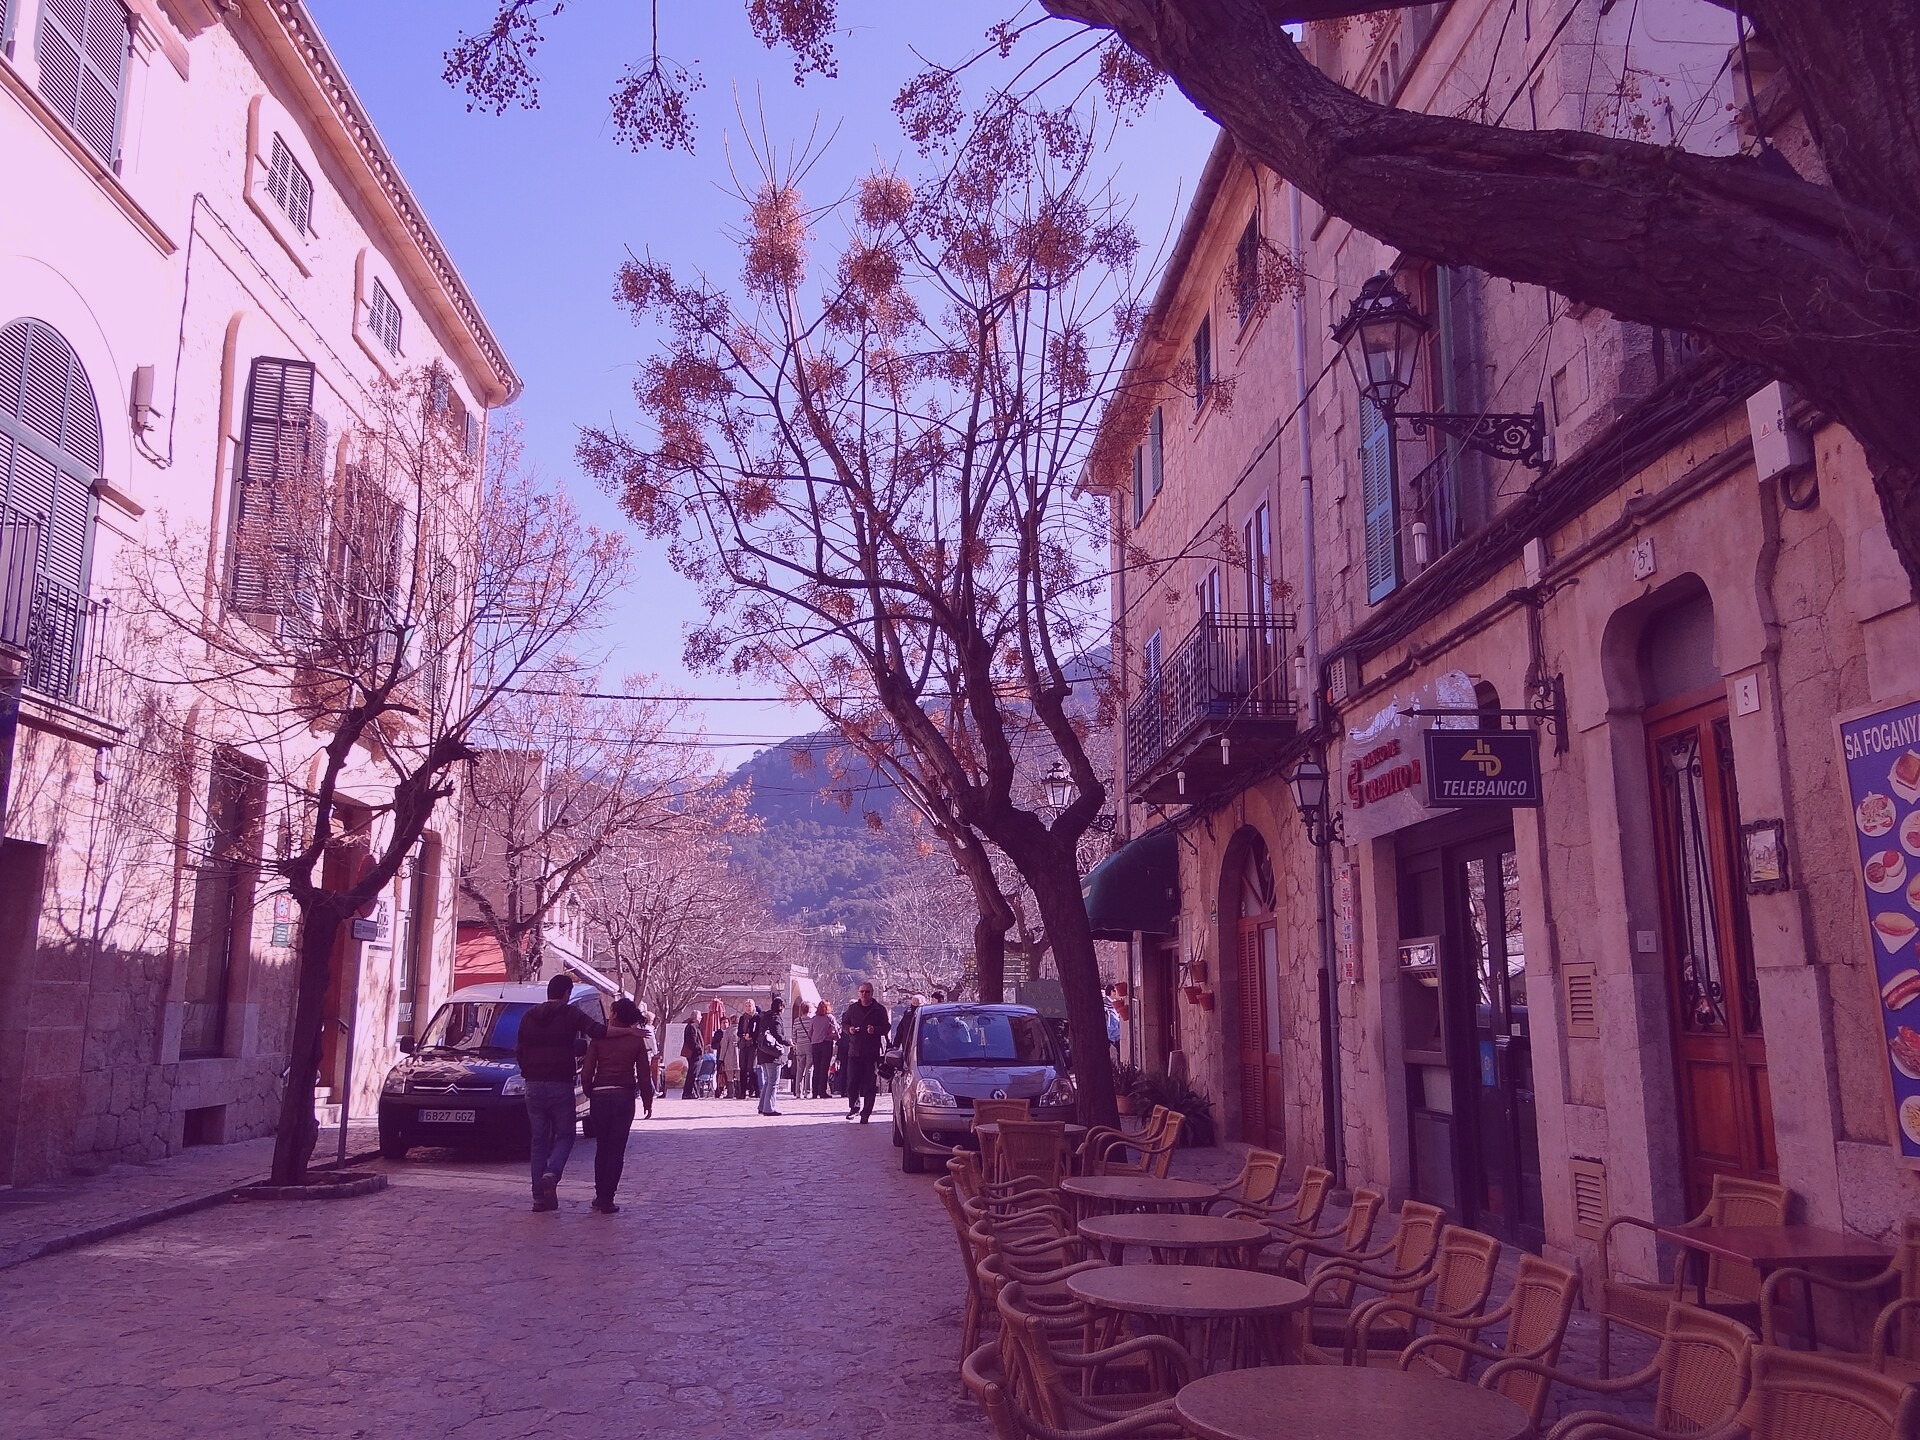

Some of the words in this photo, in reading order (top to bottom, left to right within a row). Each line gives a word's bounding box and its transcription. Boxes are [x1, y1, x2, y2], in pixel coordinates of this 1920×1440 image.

[1844, 732, 1864, 760] SA
[1443, 780, 1528, 796] TELEBANCO
[425, 1111, 451, 1121] 6827
[455, 1111, 474, 1122] GGZ
